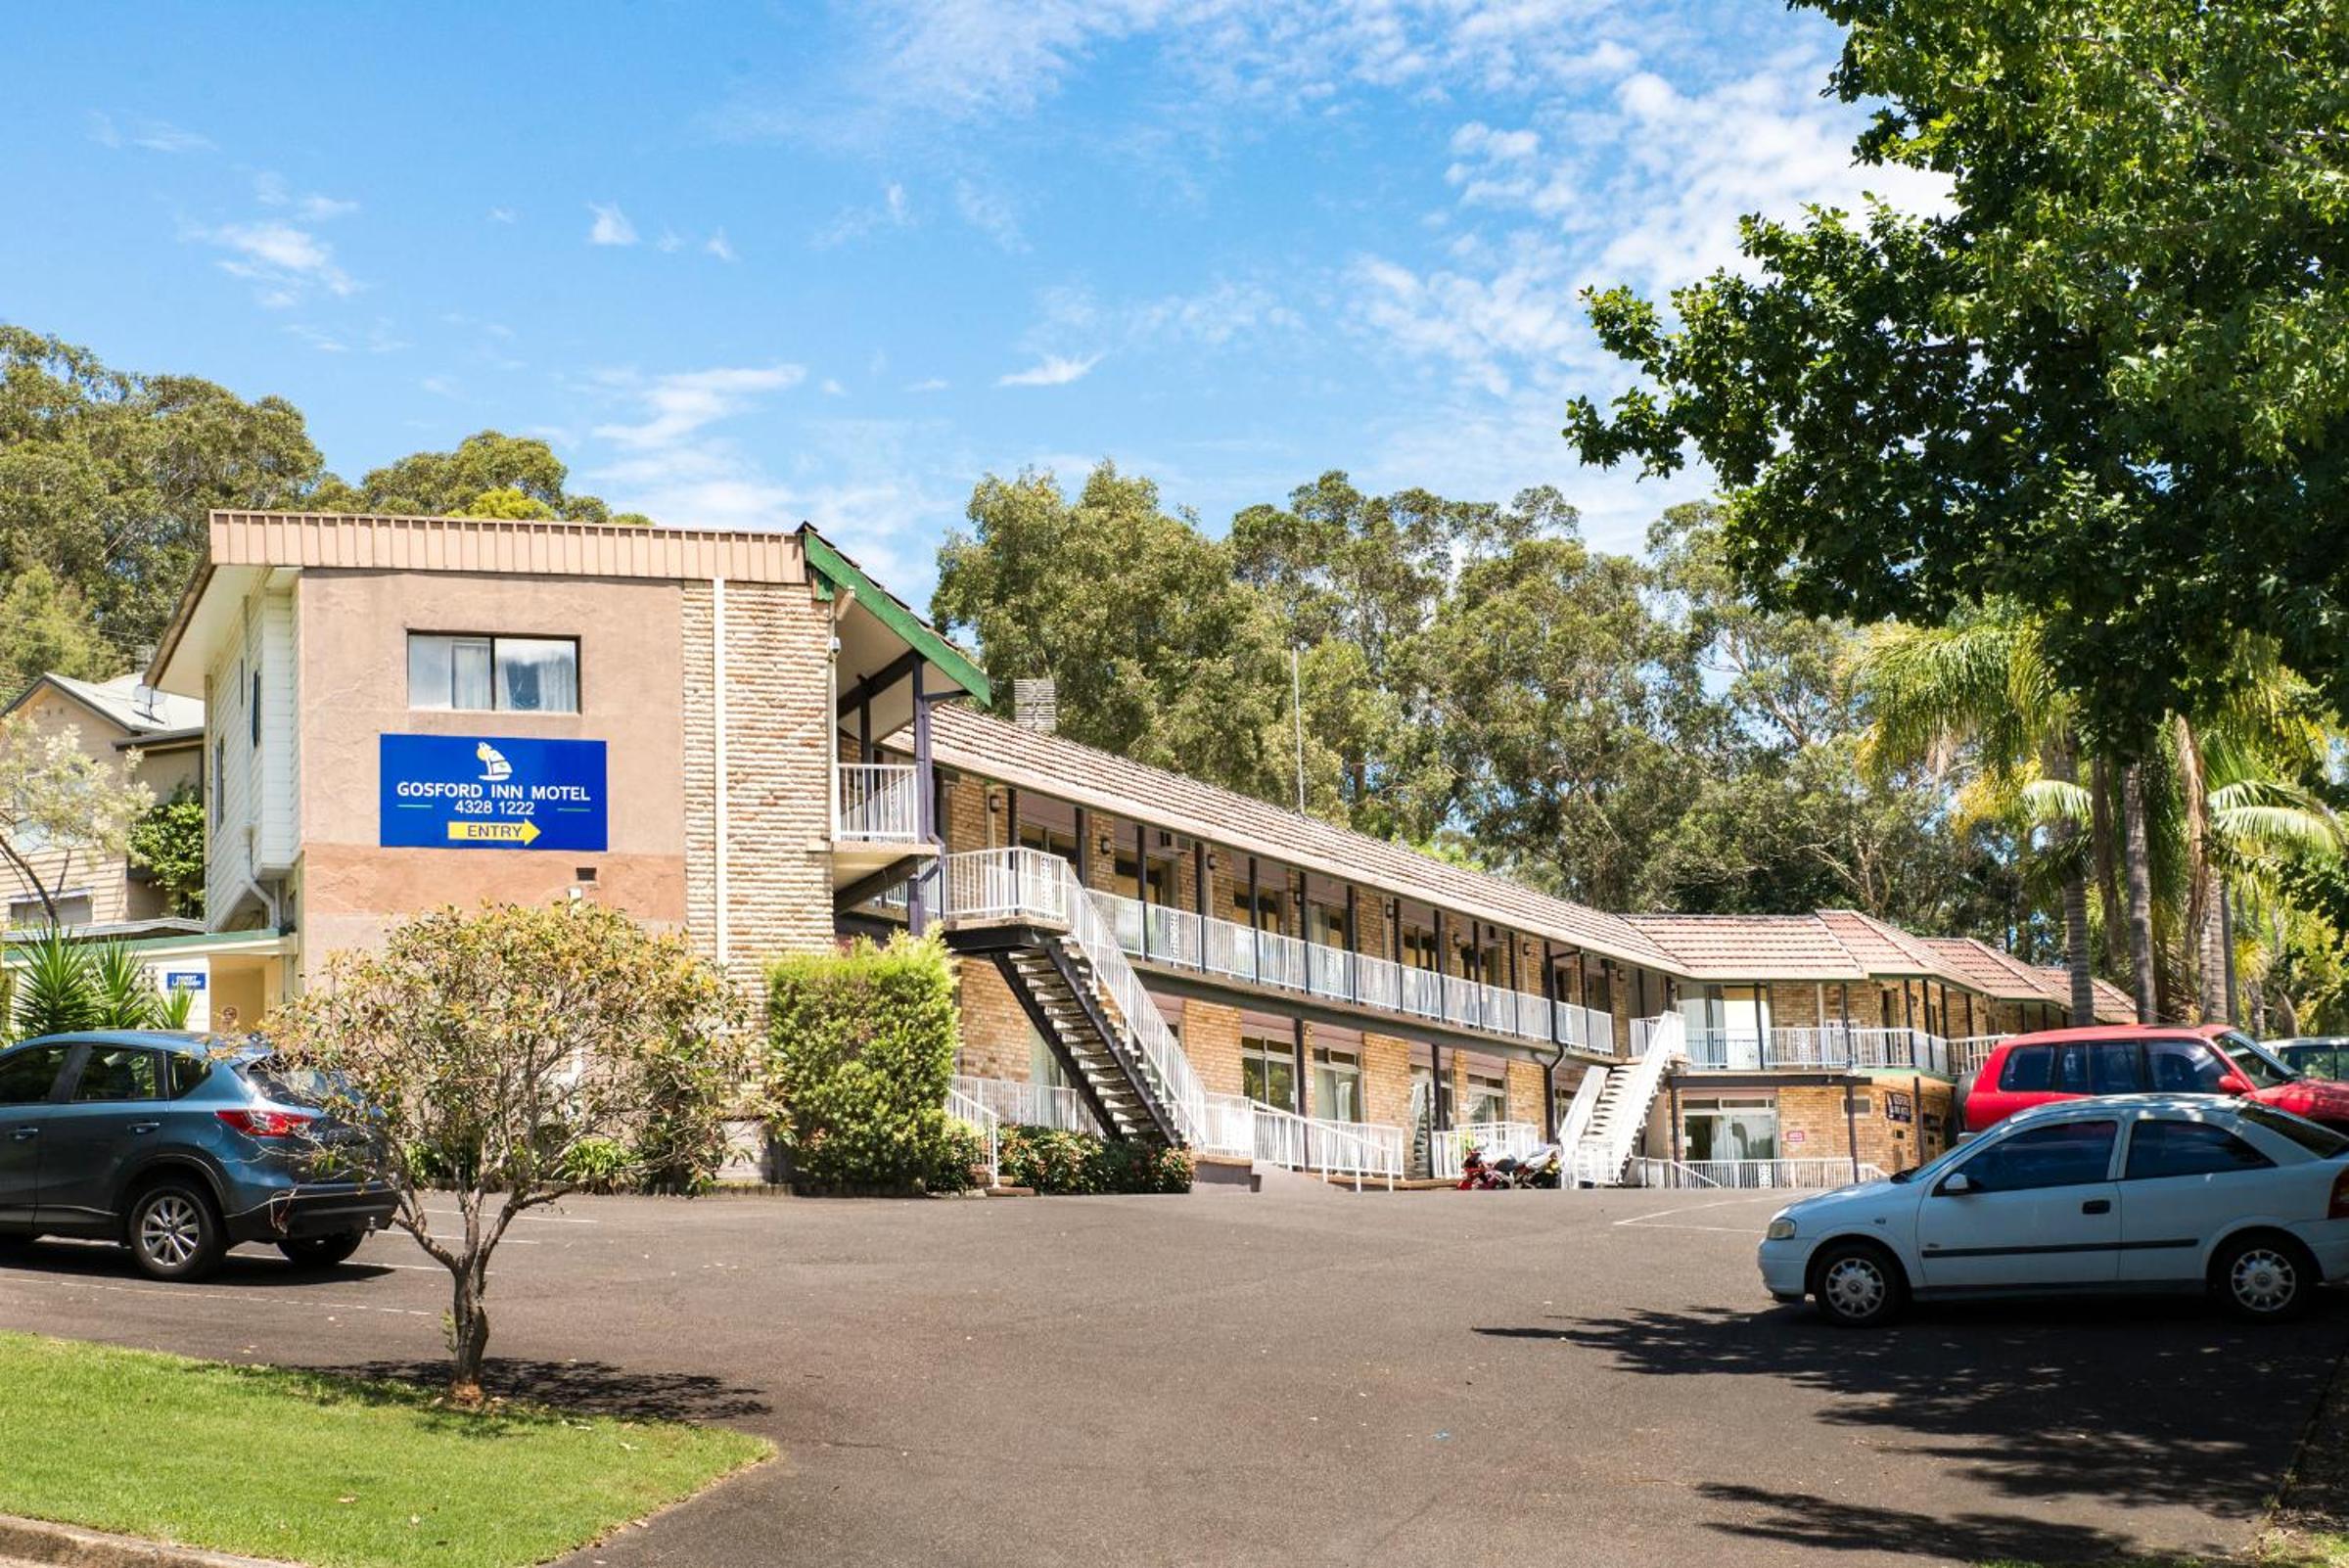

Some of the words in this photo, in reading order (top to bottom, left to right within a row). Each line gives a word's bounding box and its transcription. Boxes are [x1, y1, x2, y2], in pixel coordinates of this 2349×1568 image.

[396, 782, 483, 798] GOSFORD
[490, 784, 524, 799] INN
[531, 786, 591, 801] MOTEL
[454, 800, 492, 814] 4328
[499, 801, 534, 815] 1222
[467, 825, 523, 838] ENTRY
